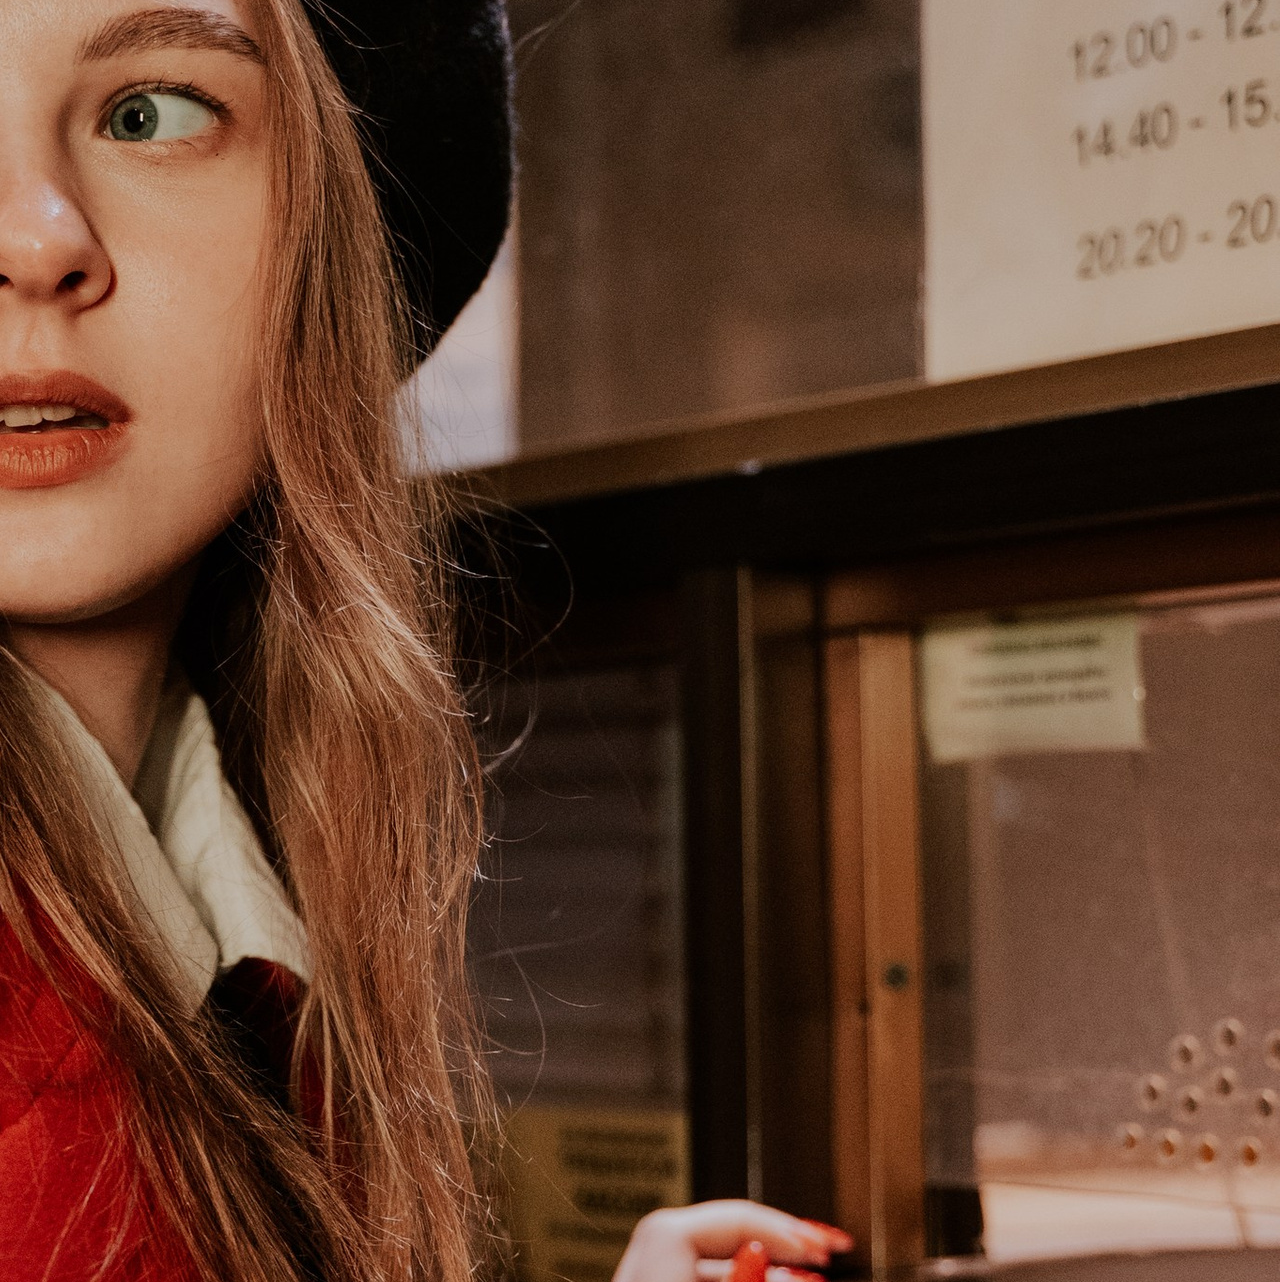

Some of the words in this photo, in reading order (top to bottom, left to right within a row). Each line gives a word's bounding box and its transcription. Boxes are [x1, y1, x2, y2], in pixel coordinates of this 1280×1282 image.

[1070, 14, 1178, 84] 12.00
[1071, 100, 1179, 166] 14.40
[1075, 214, 1187, 282] 20.20
